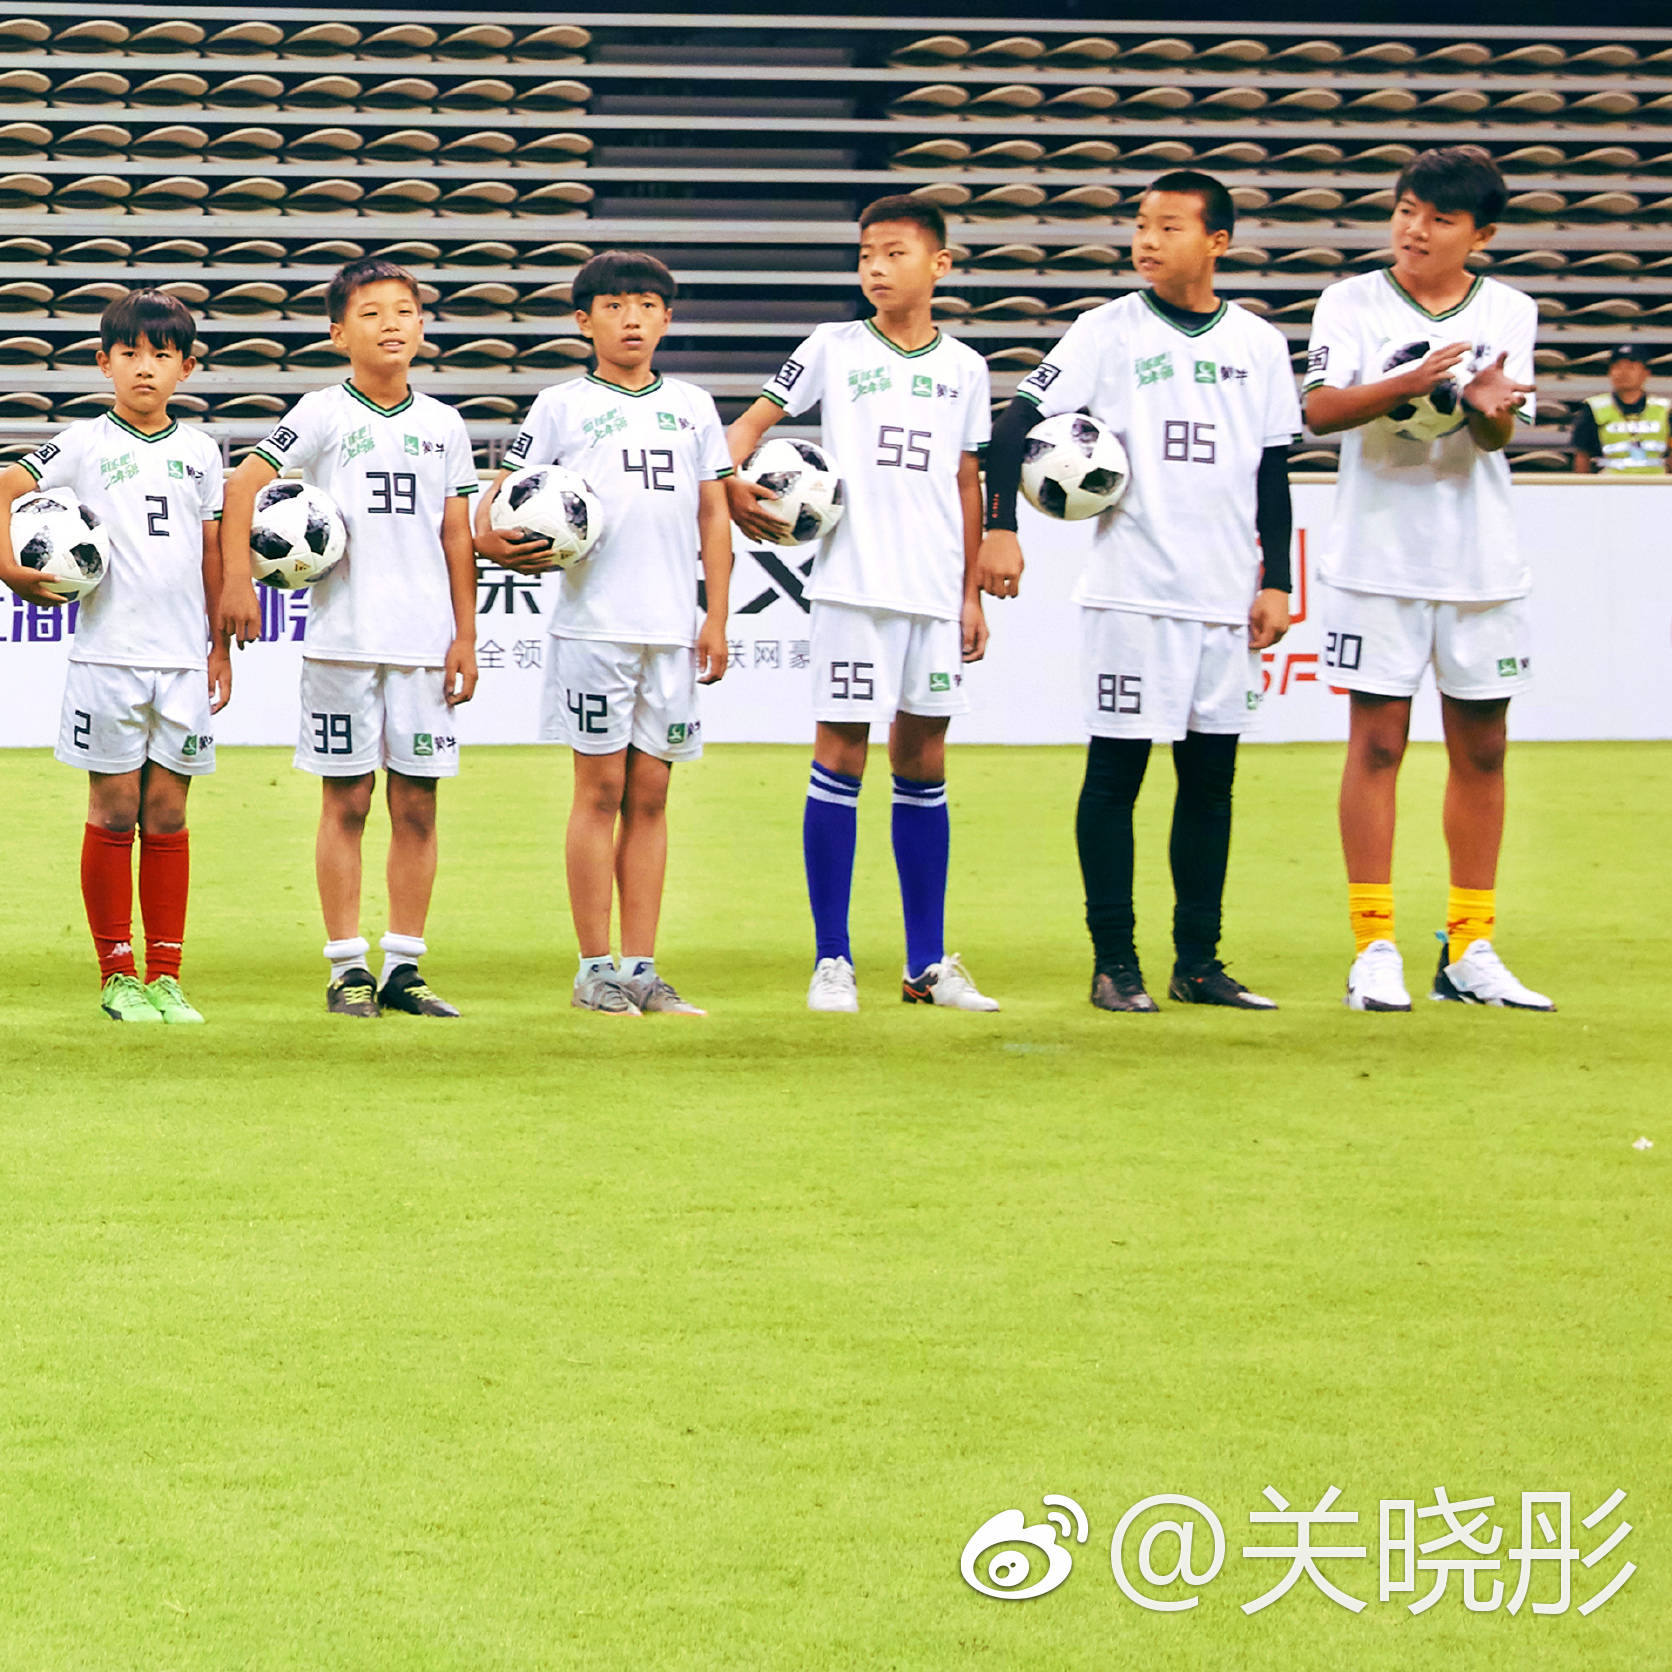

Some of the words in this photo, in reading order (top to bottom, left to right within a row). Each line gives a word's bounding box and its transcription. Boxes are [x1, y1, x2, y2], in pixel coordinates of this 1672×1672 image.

[876, 425, 932, 472] 55
[1163, 420, 1216, 465] 85
[622, 448, 675, 491] 42
[365, 471, 417, 515] 39
[145, 495, 171, 537] 2
[1325, 631, 1362, 671] 20
[830, 661, 874, 701] 55
[1097, 673, 1142, 715] 85
[74, 709, 92, 751] 2
[567, 688, 608, 734] 42
[312, 712, 353, 755] 39
